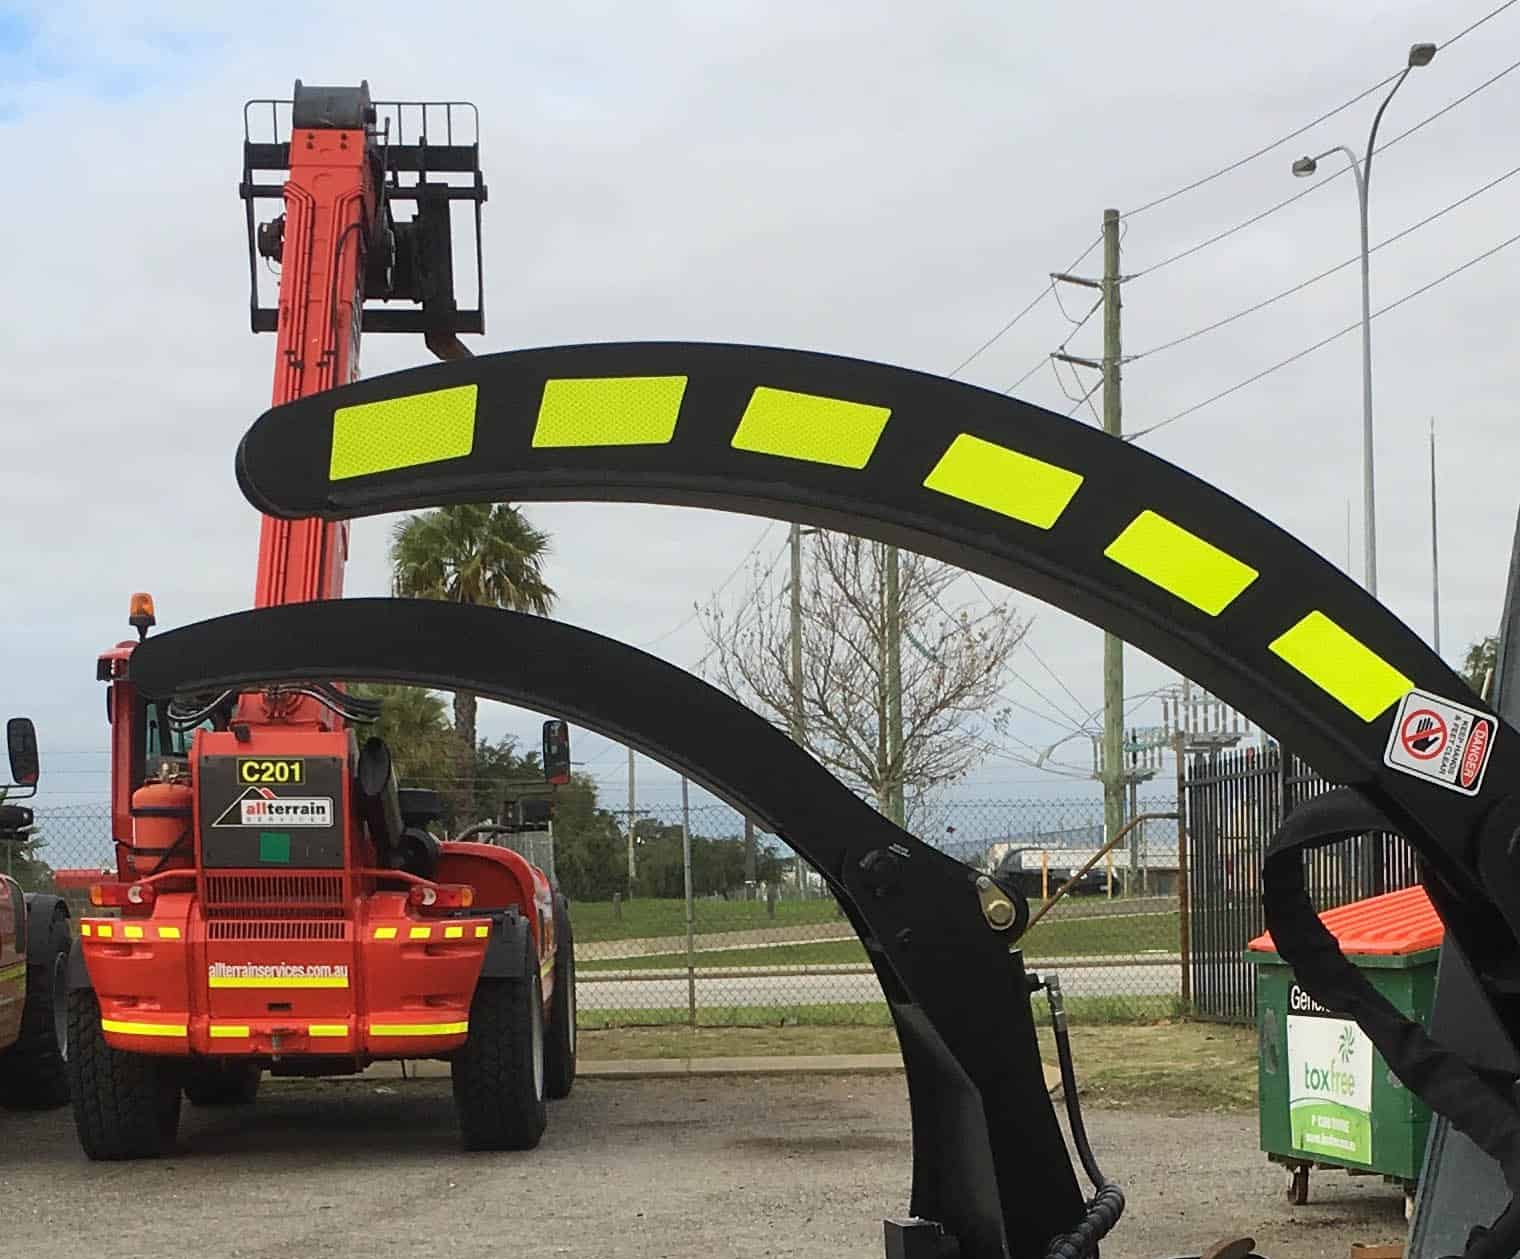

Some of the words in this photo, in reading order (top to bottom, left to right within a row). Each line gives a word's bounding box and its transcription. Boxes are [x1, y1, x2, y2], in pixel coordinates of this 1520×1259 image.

[1463, 731, 1485, 777] DANGER
[241, 761, 301, 782] C201
[245, 801, 326, 815] allterrain
[208, 962, 348, 977] allterrainservices.com.au
[1304, 1057, 1354, 1097] toxfree
